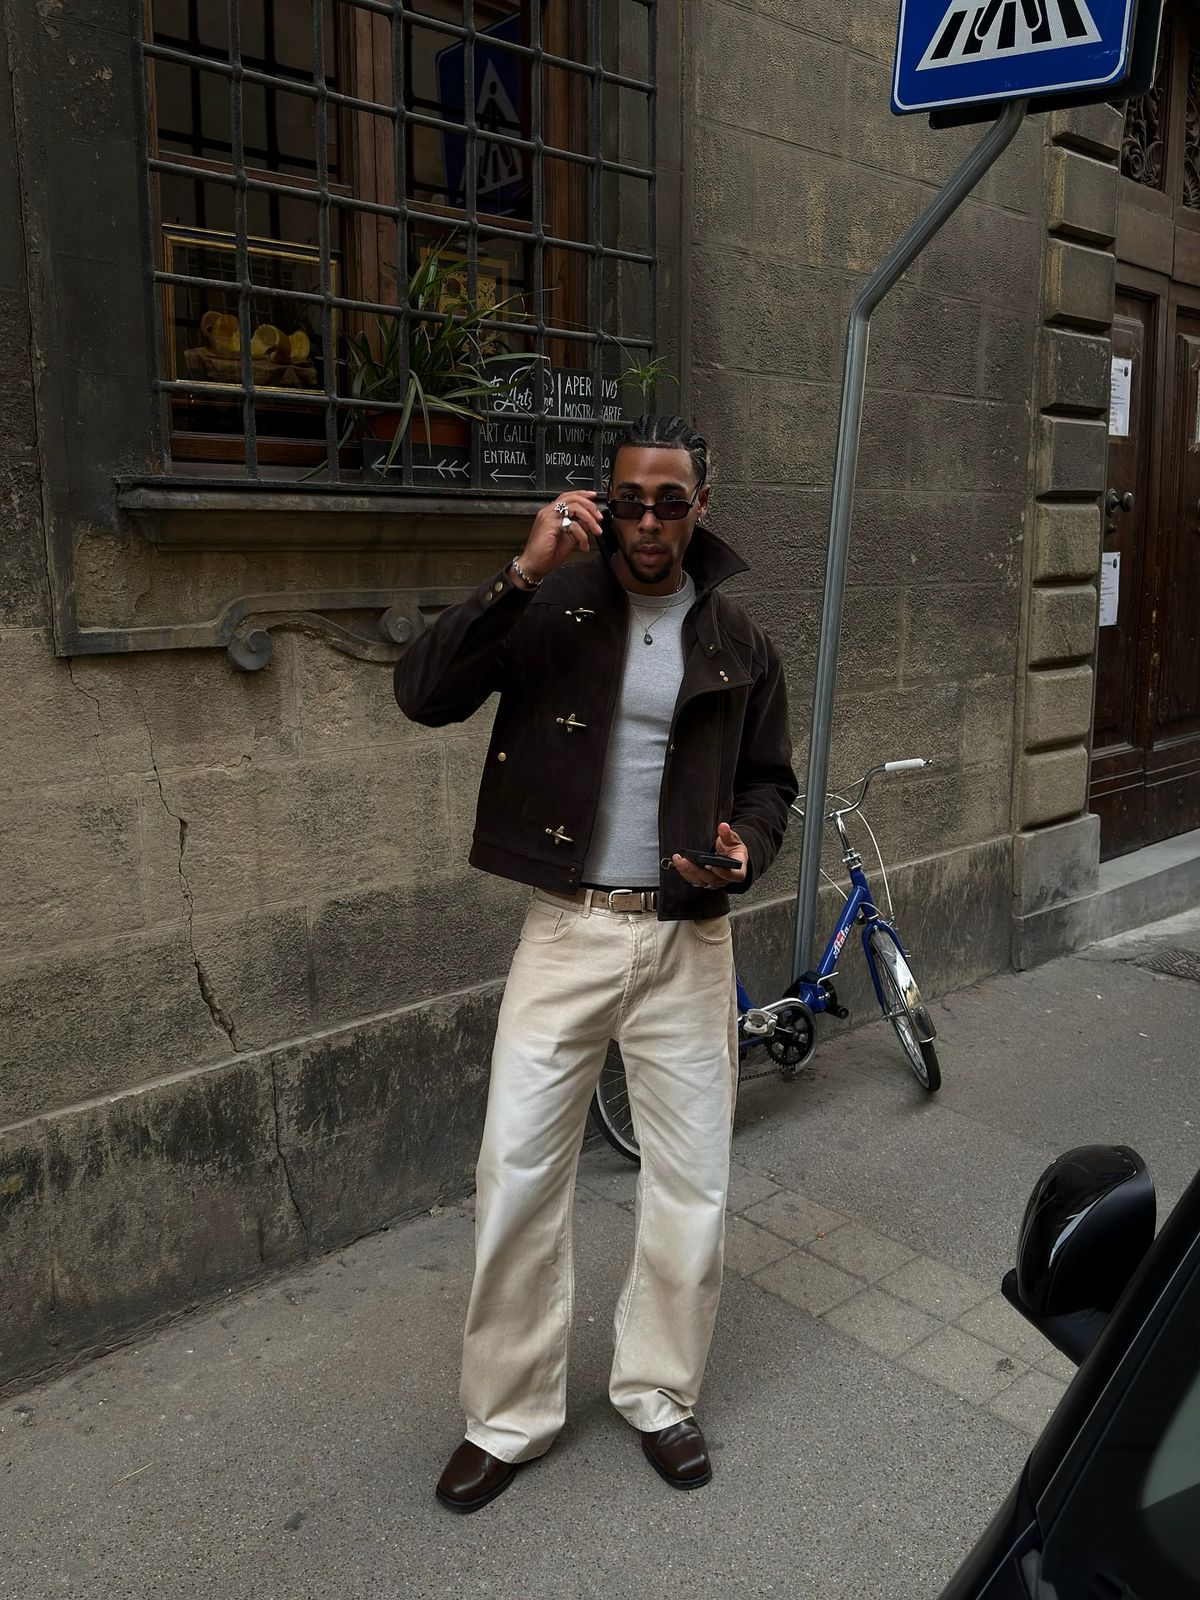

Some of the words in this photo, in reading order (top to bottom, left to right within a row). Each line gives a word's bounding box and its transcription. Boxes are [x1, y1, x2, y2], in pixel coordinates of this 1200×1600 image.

[564, 376, 618, 399] APERIVO
[479, 423, 500, 442] ART
[504, 424, 546, 443] GALLE
[484, 450, 527, 466] ENTRATA
[545, 452, 572, 466] DIETRO
[574, 453, 610, 469] L'ANGO
